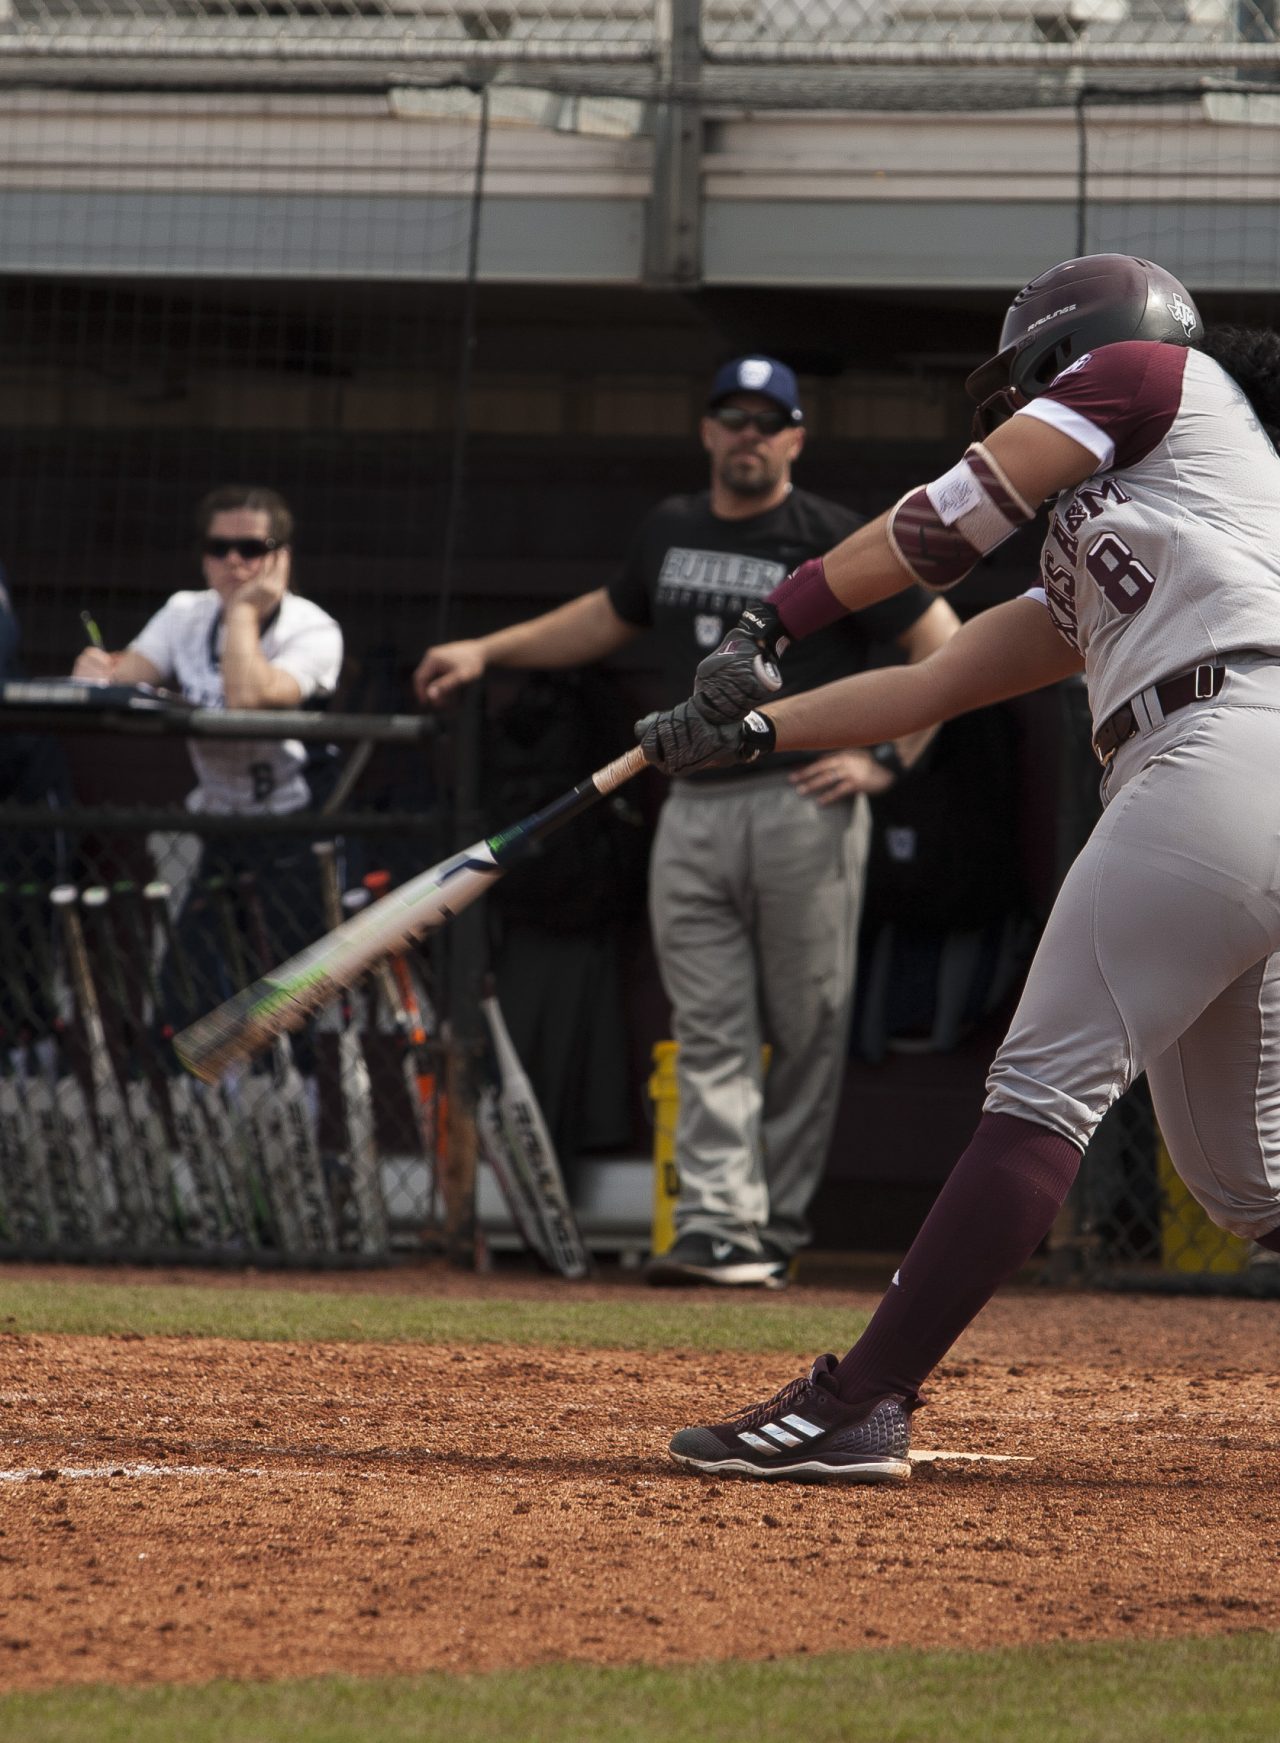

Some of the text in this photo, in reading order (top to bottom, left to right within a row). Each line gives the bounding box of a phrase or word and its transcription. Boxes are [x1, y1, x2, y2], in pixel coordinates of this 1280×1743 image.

[1027, 303, 1078, 333] RAWLINGS
[1052, 477, 1132, 568] A&M
[1086, 531, 1157, 615] 8
